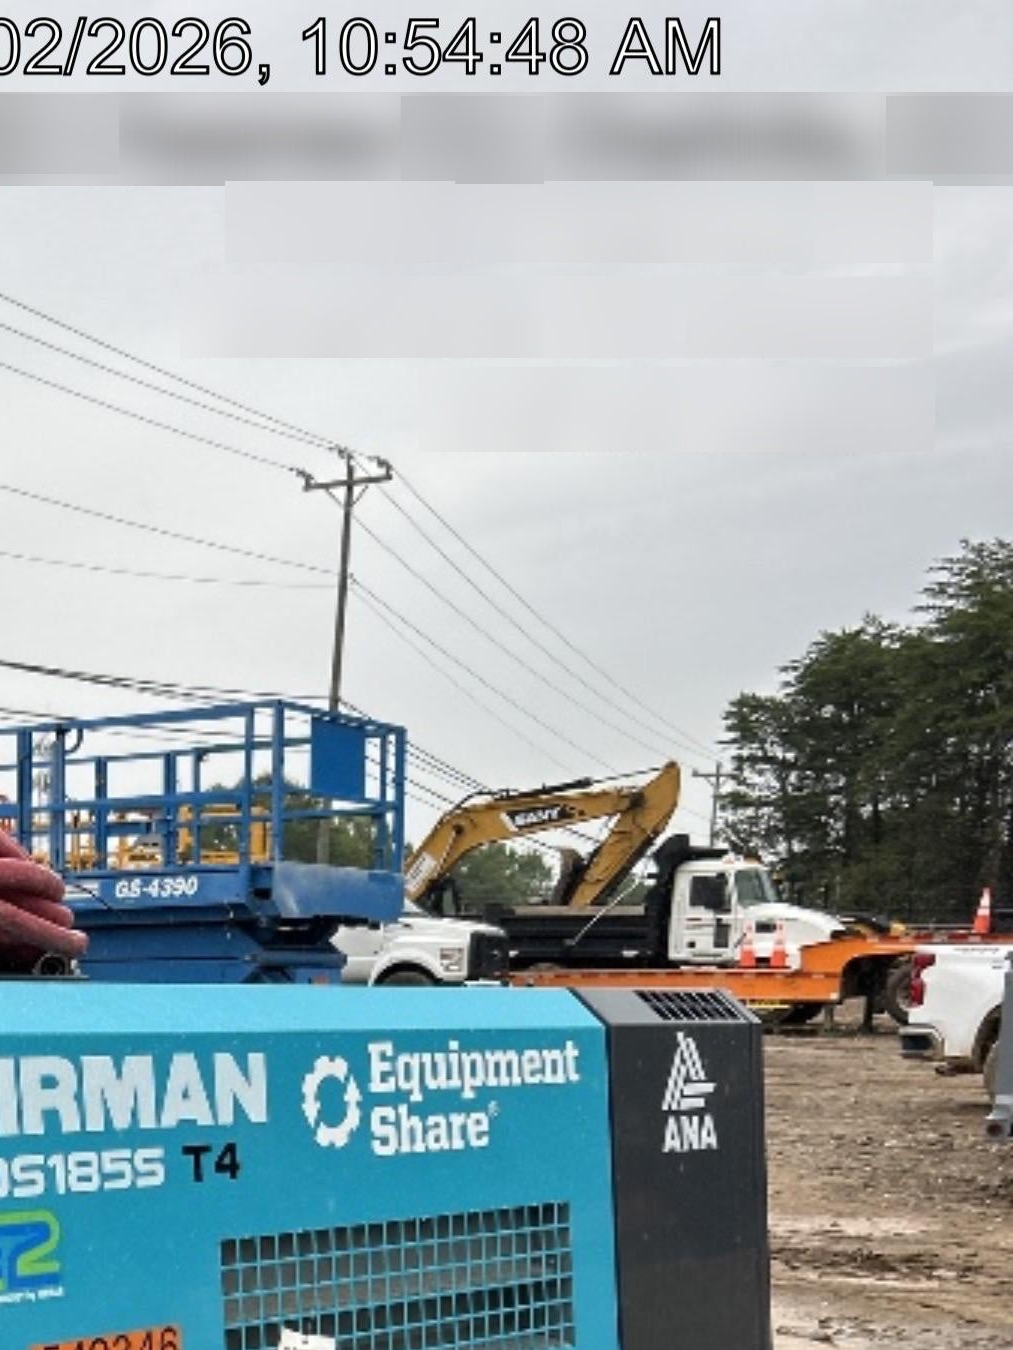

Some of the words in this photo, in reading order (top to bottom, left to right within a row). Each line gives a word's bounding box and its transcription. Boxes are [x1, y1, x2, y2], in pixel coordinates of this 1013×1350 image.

[115, 875, 198, 898] GS-4390
[367, 1040, 580, 1102] Equipment
[662, 1114, 718, 1153] ANA
[181, 1142, 241, 1183] T4
